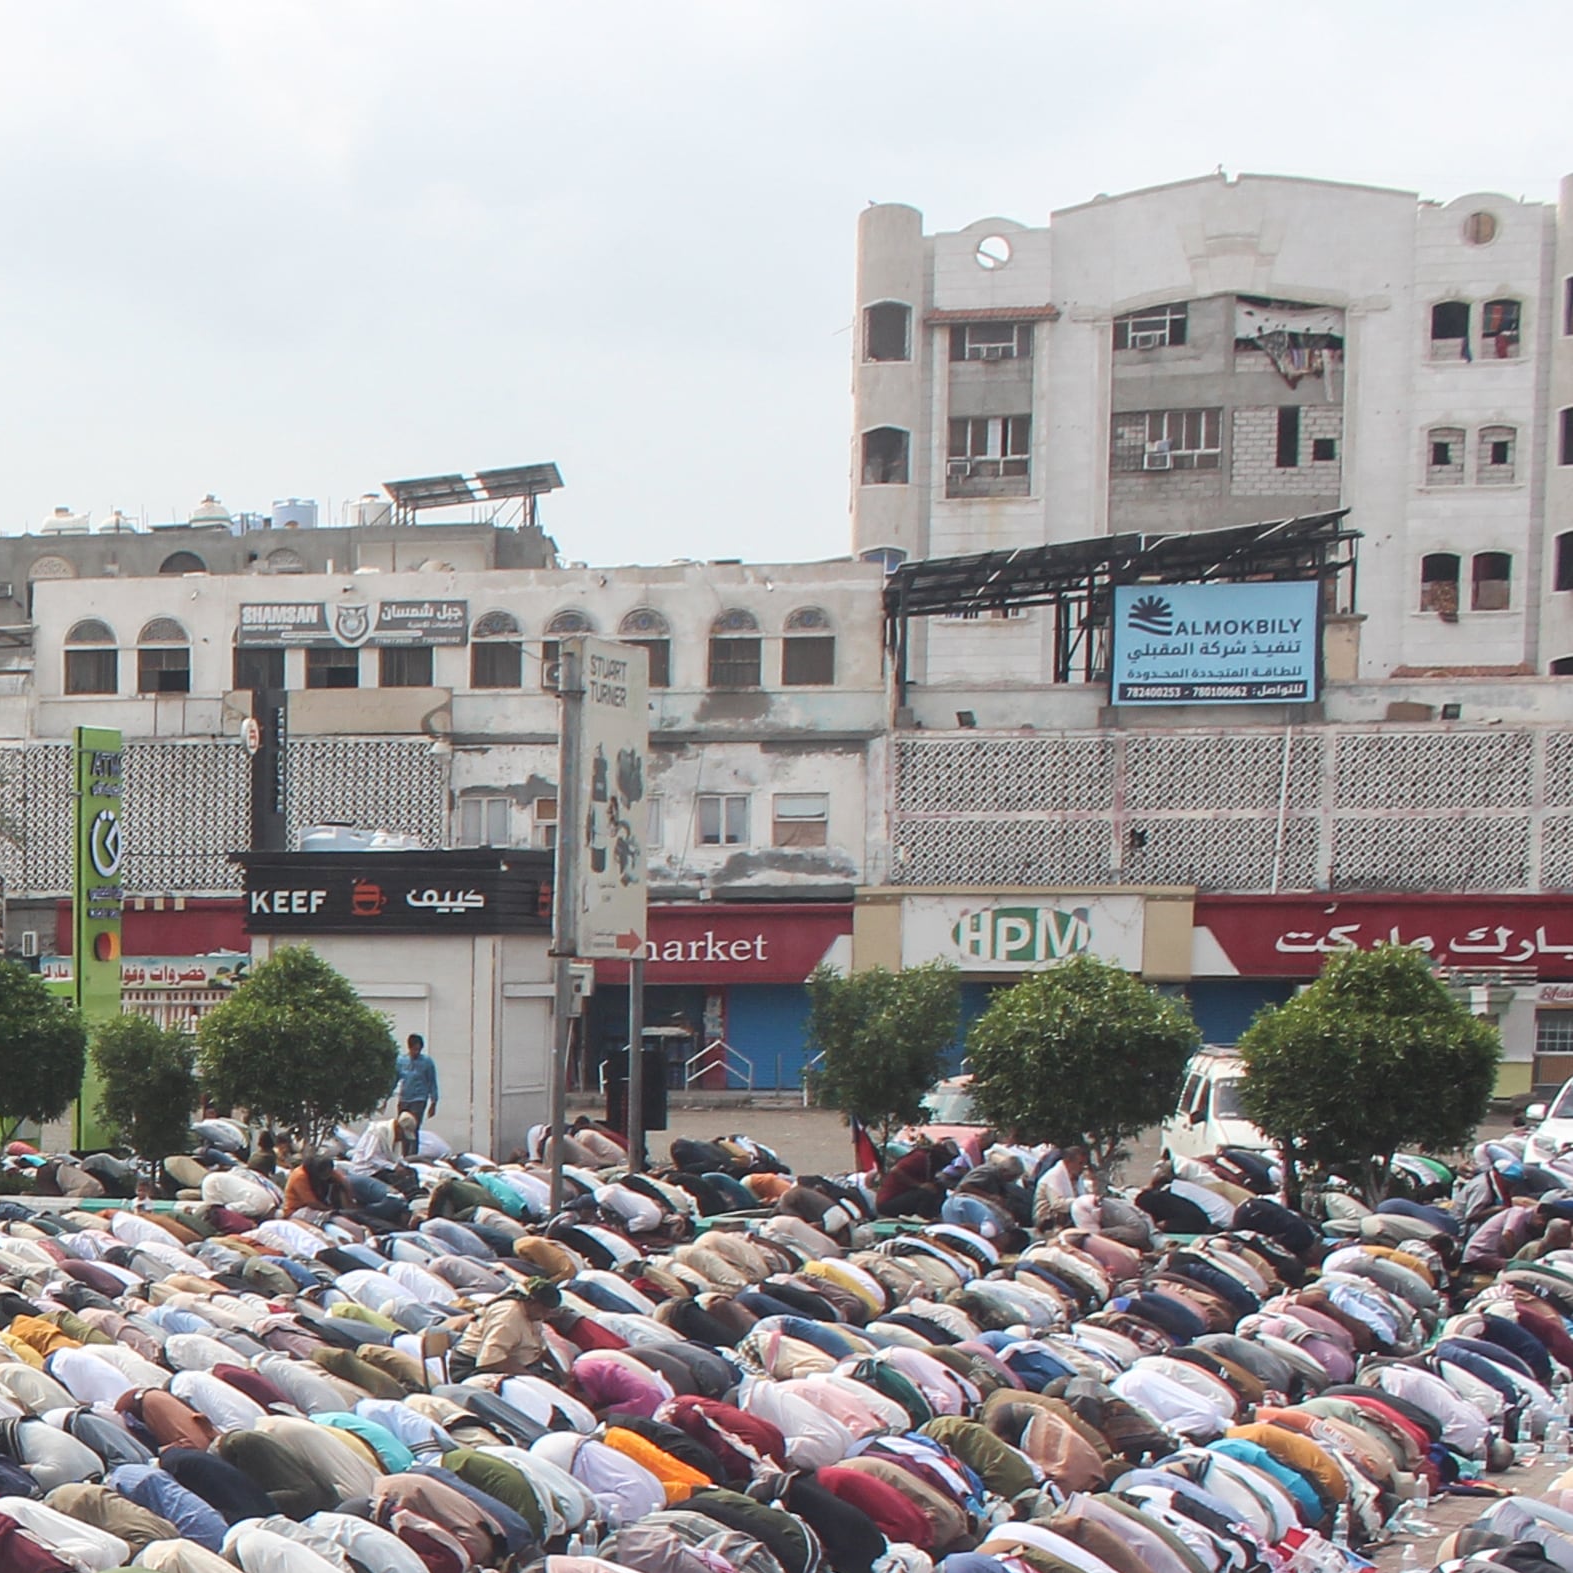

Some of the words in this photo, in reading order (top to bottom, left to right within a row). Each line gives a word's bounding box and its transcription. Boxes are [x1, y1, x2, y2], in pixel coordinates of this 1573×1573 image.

[242, 605, 318, 624] SHAMSAN
[381, 602, 434, 621] شمسان
[436, 603, 463, 621] جبل
[1175, 618, 1303, 636] ALMOKBILY
[1127, 641, 1194, 664] المقبلي
[1199, 640, 1247, 659] شركة
[1251, 640, 1302, 657] تنفيذ
[590, 654, 627, 682] STUART
[1251, 665, 1302, 677] للطاقة
[590, 680, 627, 708] TURNER
[251, 890, 327, 914] KEEF
[960, 908, 1089, 961] HPM
